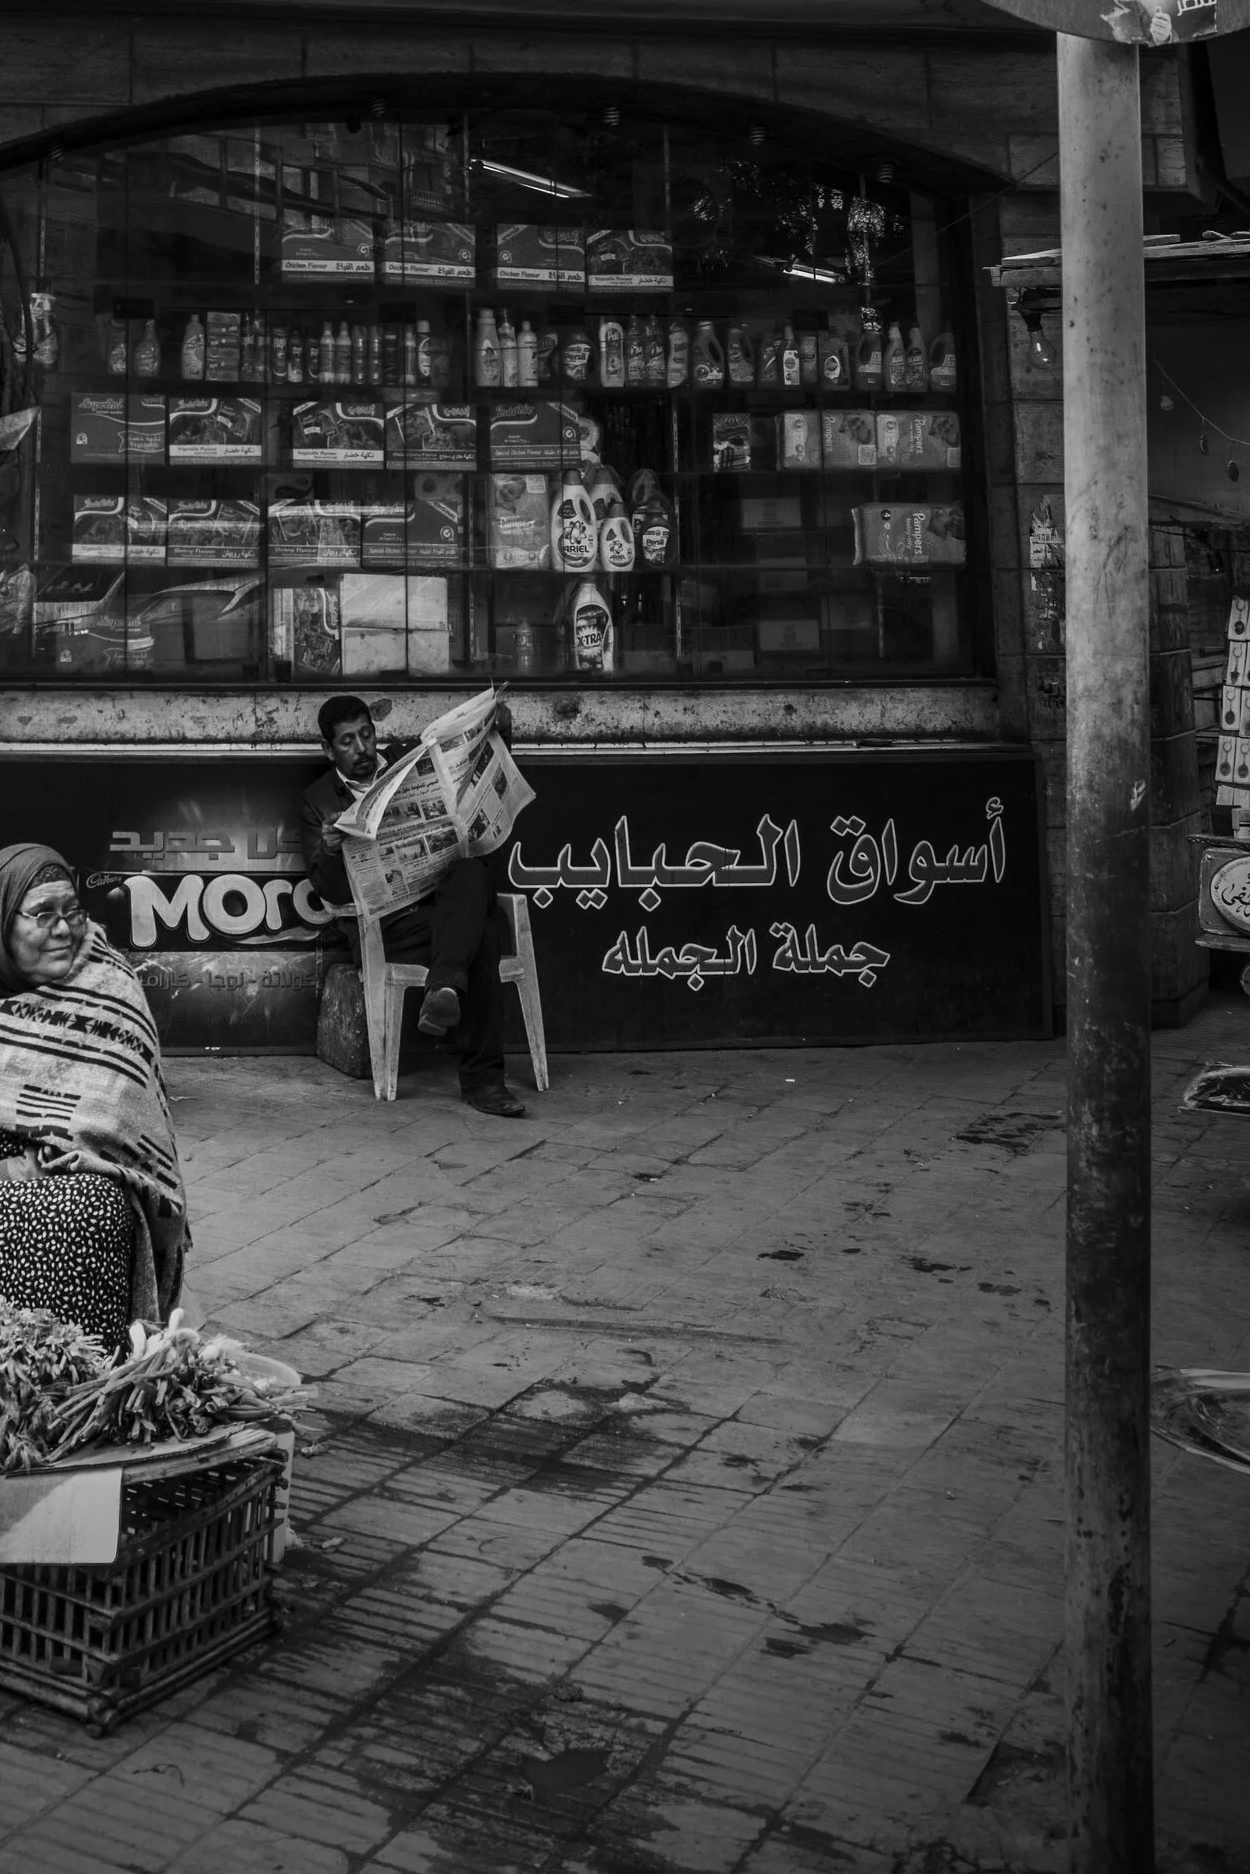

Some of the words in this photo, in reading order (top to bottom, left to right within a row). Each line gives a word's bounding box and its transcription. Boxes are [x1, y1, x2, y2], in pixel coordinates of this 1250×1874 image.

[563, 545, 590, 553] ARIEL
[913, 512, 926, 556] Pampers
[109, 830, 235, 861] جديد
[507, 814, 801, 912] الحبايب
[827, 795, 1006, 906] أسواق
[601, 923, 757, 991] الجمله
[771, 922, 891, 988] جملة
